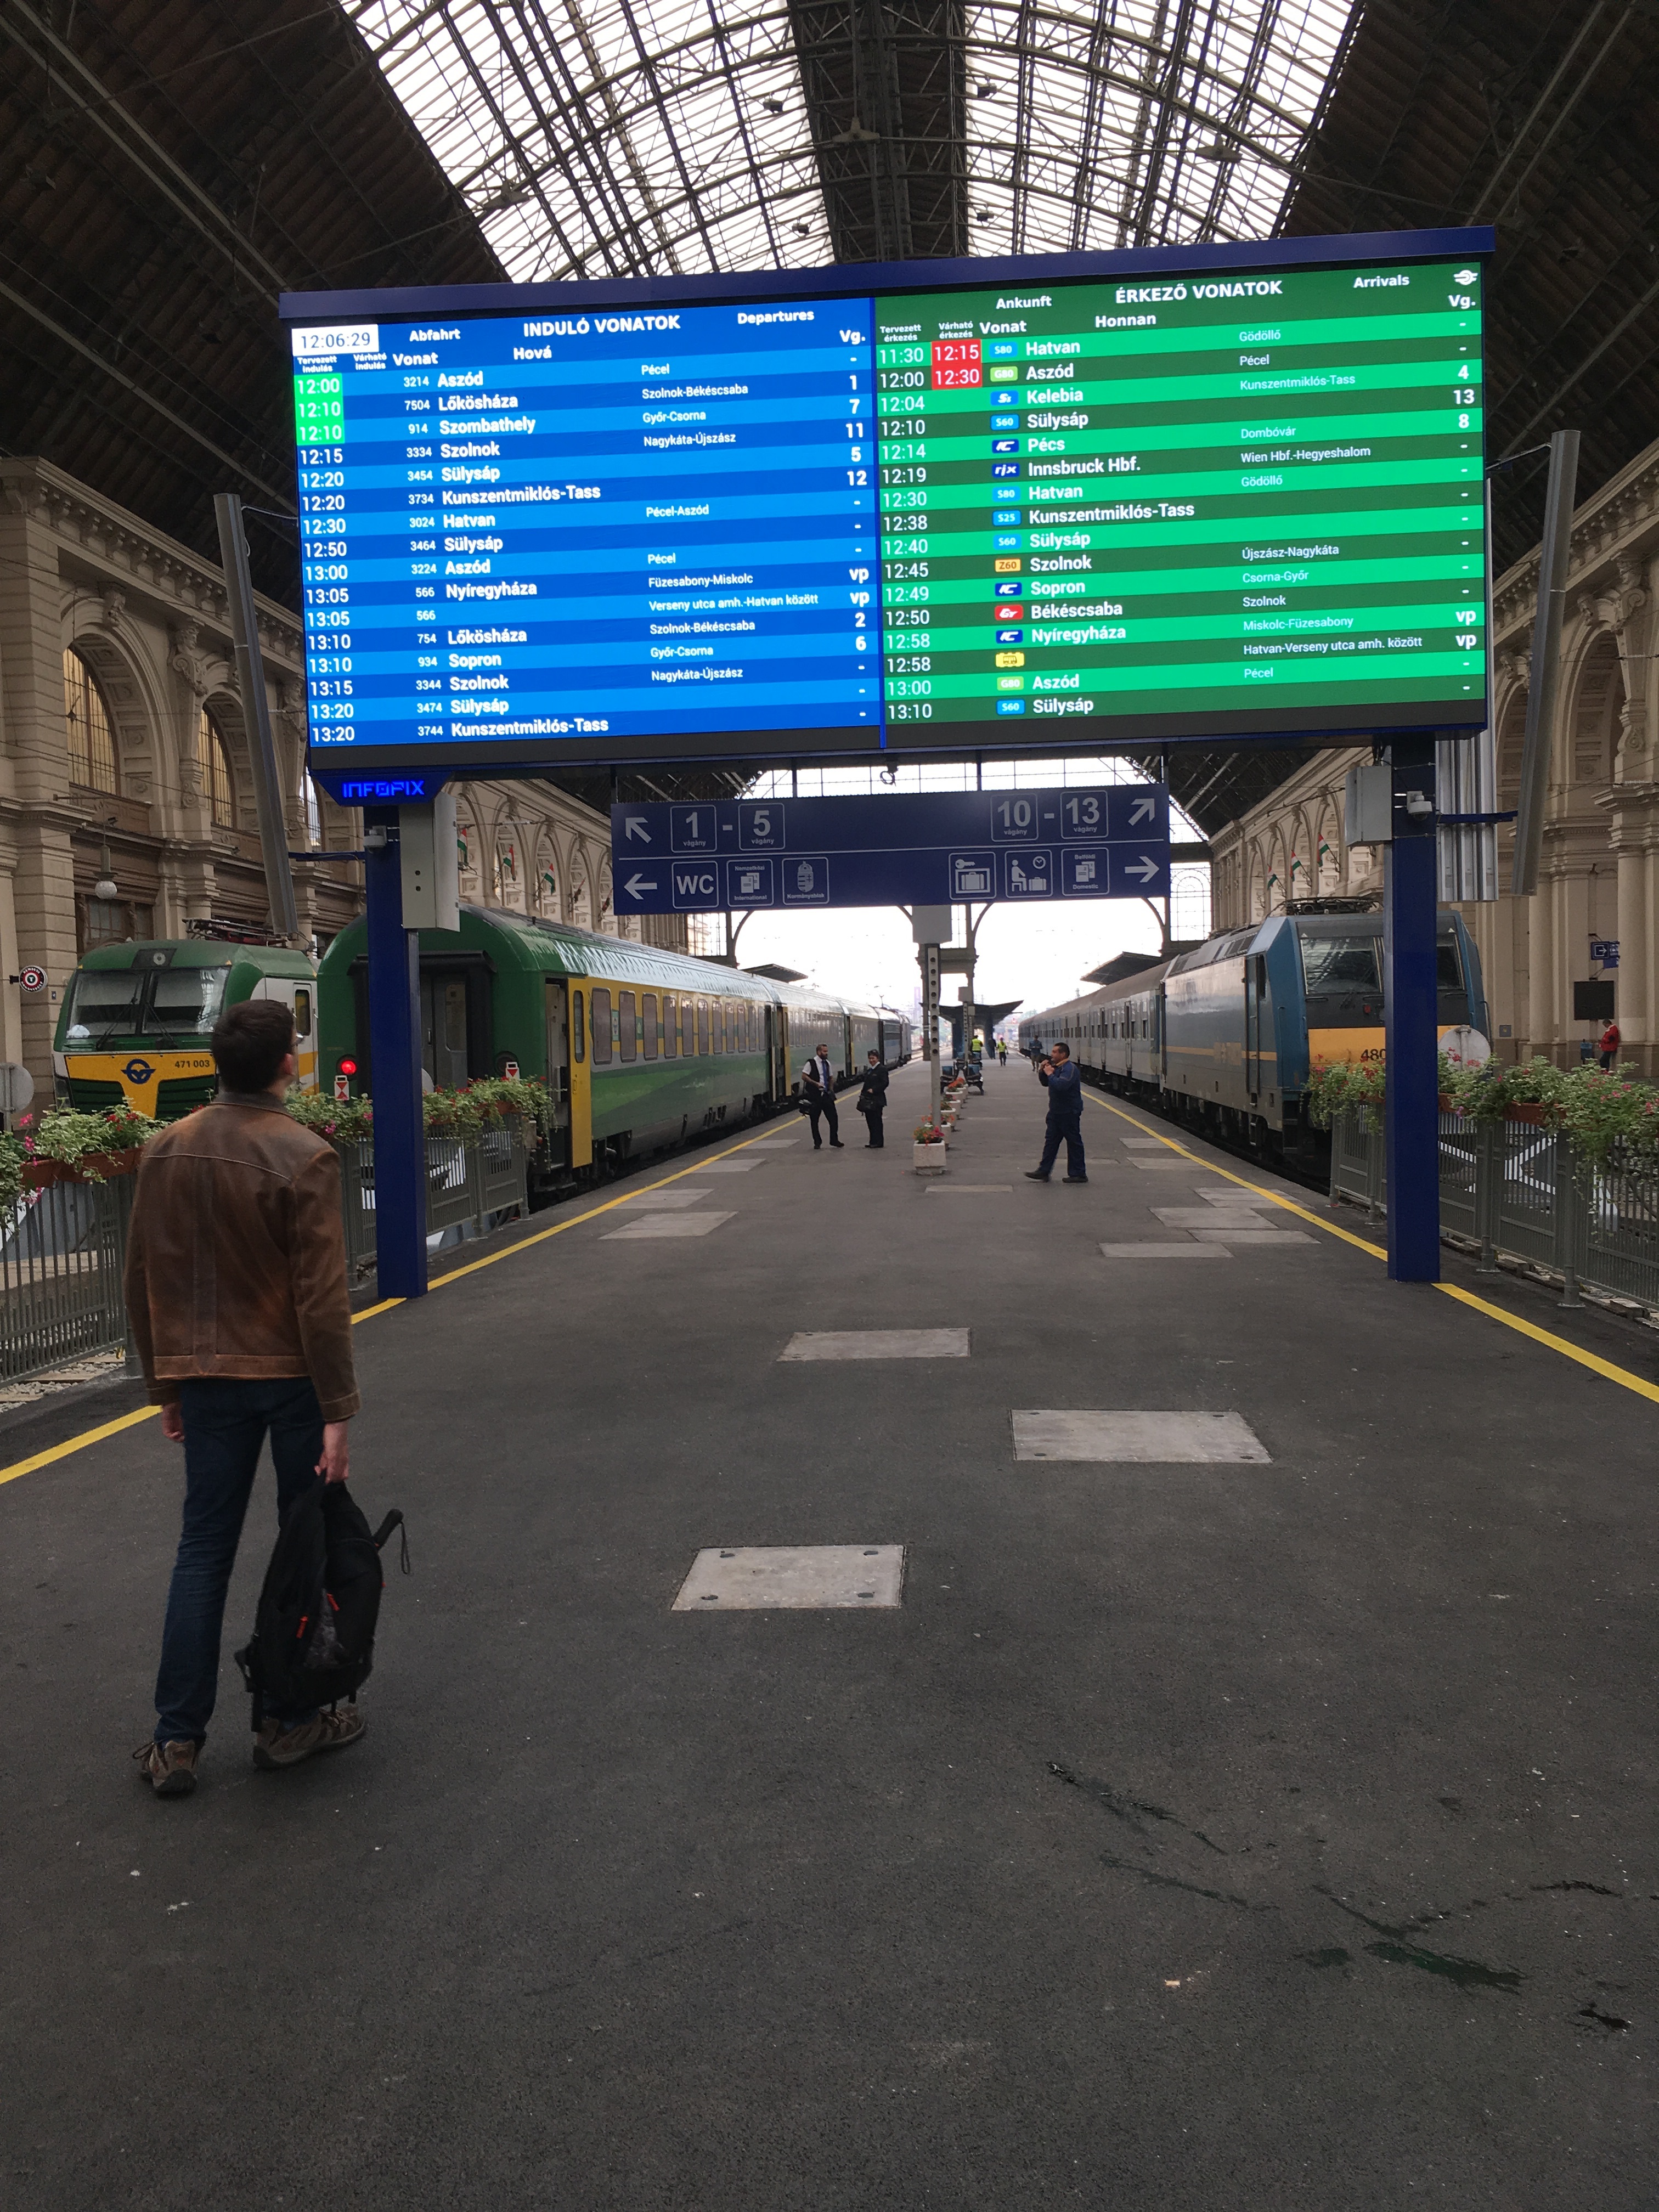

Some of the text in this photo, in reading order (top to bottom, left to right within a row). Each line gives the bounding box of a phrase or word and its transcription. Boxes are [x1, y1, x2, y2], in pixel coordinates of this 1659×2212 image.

[1116, 280, 1282, 303] ÉRKEZŐ VONATOK
[1354, 274, 1409, 288] Arrivals
[996, 296, 1052, 309] Ankunft
[524, 315, 680, 337] INDULÓ VONATOK
[737, 311, 814, 325] Departures
[880, 324, 921, 333] Tervezett
[939, 321, 973, 330] Várható
[980, 320, 1026, 334] Vonat
[1096, 315, 1156, 328] Honnan
[302, 332, 370, 348] 12:06:29
[410, 329, 460, 342] Abfahrt
[881, 330, 1280, 364] 11:30 12:15 Hatvan Gödöllő
[884, 333, 917, 342] érkezés
[940, 330, 972, 338] érkezés
[393, 352, 438, 366] Vonat
[514, 345, 551, 360] Hová
[298, 364, 669, 394] 12:00 3214 Aszód Pécel
[881, 354, 1269, 387] 12:00 12:30 Aszód Pécel
[300, 383, 748, 417] 12:10 7504 Lőkösháza Szolnok-Békéscsaba
[882, 375, 1356, 411] 12:04 Kelebia Kunszentmiklós-Tass
[300, 411, 706, 441] 12:10 914 Szombathely Győr-Csorna
[882, 389, 1474, 436] 12:10 Sülysáp 13
[301, 423, 862, 464] 12:15 3334 Szolnok Nagykáta-Újszász 11
[883, 426, 1296, 460] 12:14 Pécs Dombóvár
[301, 465, 500, 488] 12:20 3454 Sülysáp
[883, 447, 1370, 483] 12:19 Innsbruck Hbf. Wien Hbf.-Hegyeshalom
[303, 470, 867, 511] 12:20 3734 Kunszentmiklós-Tass 12
[884, 475, 1283, 507] 12:30 Hatvan Gödöllő
[303, 504, 709, 534] 12:30 3024 Hatvan Pécel-Aszód
[884, 504, 1194, 531] 12:38 Kunszentmiklós-Tass
[304, 535, 503, 557] 12:50 3464 Sülysáp
[885, 532, 1090, 555] 12:40 Sülysáp
[306, 552, 676, 580] 13:00 3224 Aszód Pécel
[885, 545, 1339, 578] 12:45 Szolnok Újszász-Nagykáta
[307, 573, 753, 603] 13:05 566 Nyíregyháza Füzesabony-Miskolc
[887, 570, 1308, 602] 12:49 Sopron Csorna-Győr
[308, 594, 818, 627] 13:05 566 Verseny utca amh.-Hatvan között
[887, 595, 1285, 625] 12:50 Békéscsaba Szolnok
[309, 620, 755, 650] 13:10 754 Lőkösháza Szolnok-Békéscsaba
[888, 617, 1353, 649] 12:58 Nyíregyháza Miskolc-Füzesabony
[309, 646, 713, 673] 13:10 934 Sopron Győr-Csorna
[888, 637, 1422, 672] 12:58 Hatvan-Verseny utca amh. között
[311, 667, 743, 696] 13:15 3344 Szolnok Nagykáta-Újszász
[888, 667, 1273, 695] 13:00 Aszód Pécel
[312, 698, 509, 719] 13:20 3474 Sülysáp
[889, 698, 1093, 719] 13:10 Sülysáp
[313, 718, 608, 742] 13:20 3744 Kunszentmiklós-Tass
[342, 781, 425, 797] INFOPIX
[753, 810, 771, 837] 5
[997, 800, 1031, 827] 10
[1066, 797, 1100, 825] 13
[686, 812, 698, 838] 1
[676, 874, 714, 895] WC
